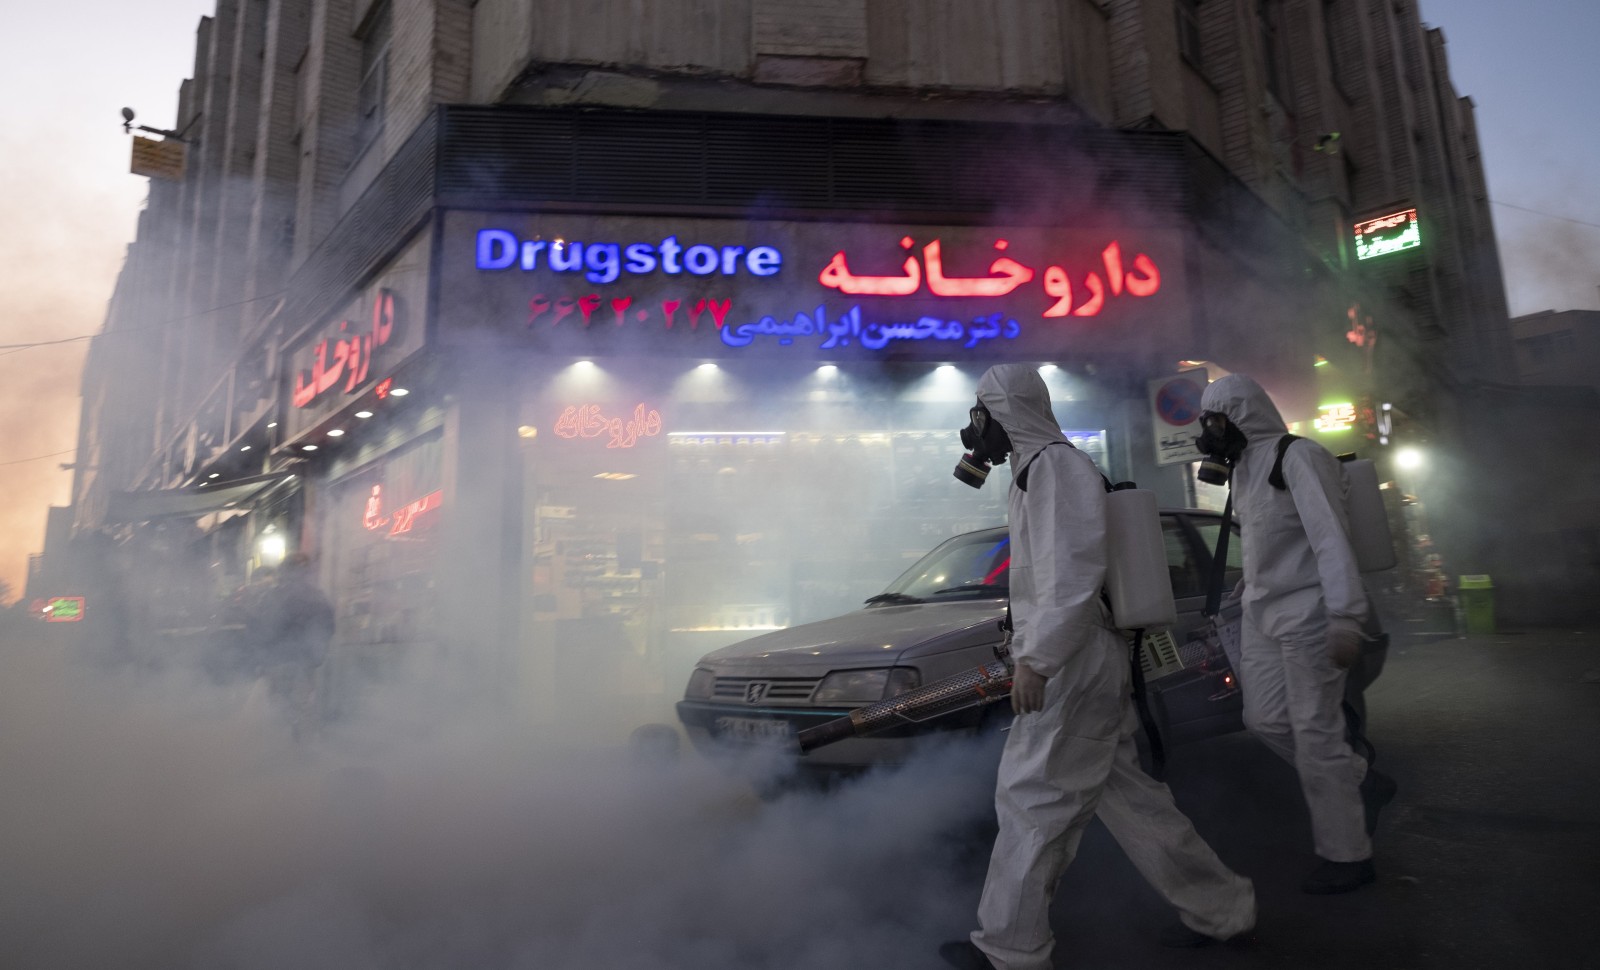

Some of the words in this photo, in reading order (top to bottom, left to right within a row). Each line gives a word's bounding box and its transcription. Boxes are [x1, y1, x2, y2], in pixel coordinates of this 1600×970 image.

[475, 228, 783, 285] Drugstore
[817, 236, 1162, 319] داروخانه
[719, 303, 862, 349] ابراهیمی
[860, 315, 965, 351] محسن
[964, 311, 1022, 349] دکتر
[553, 402, 662, 449] داروخانه
